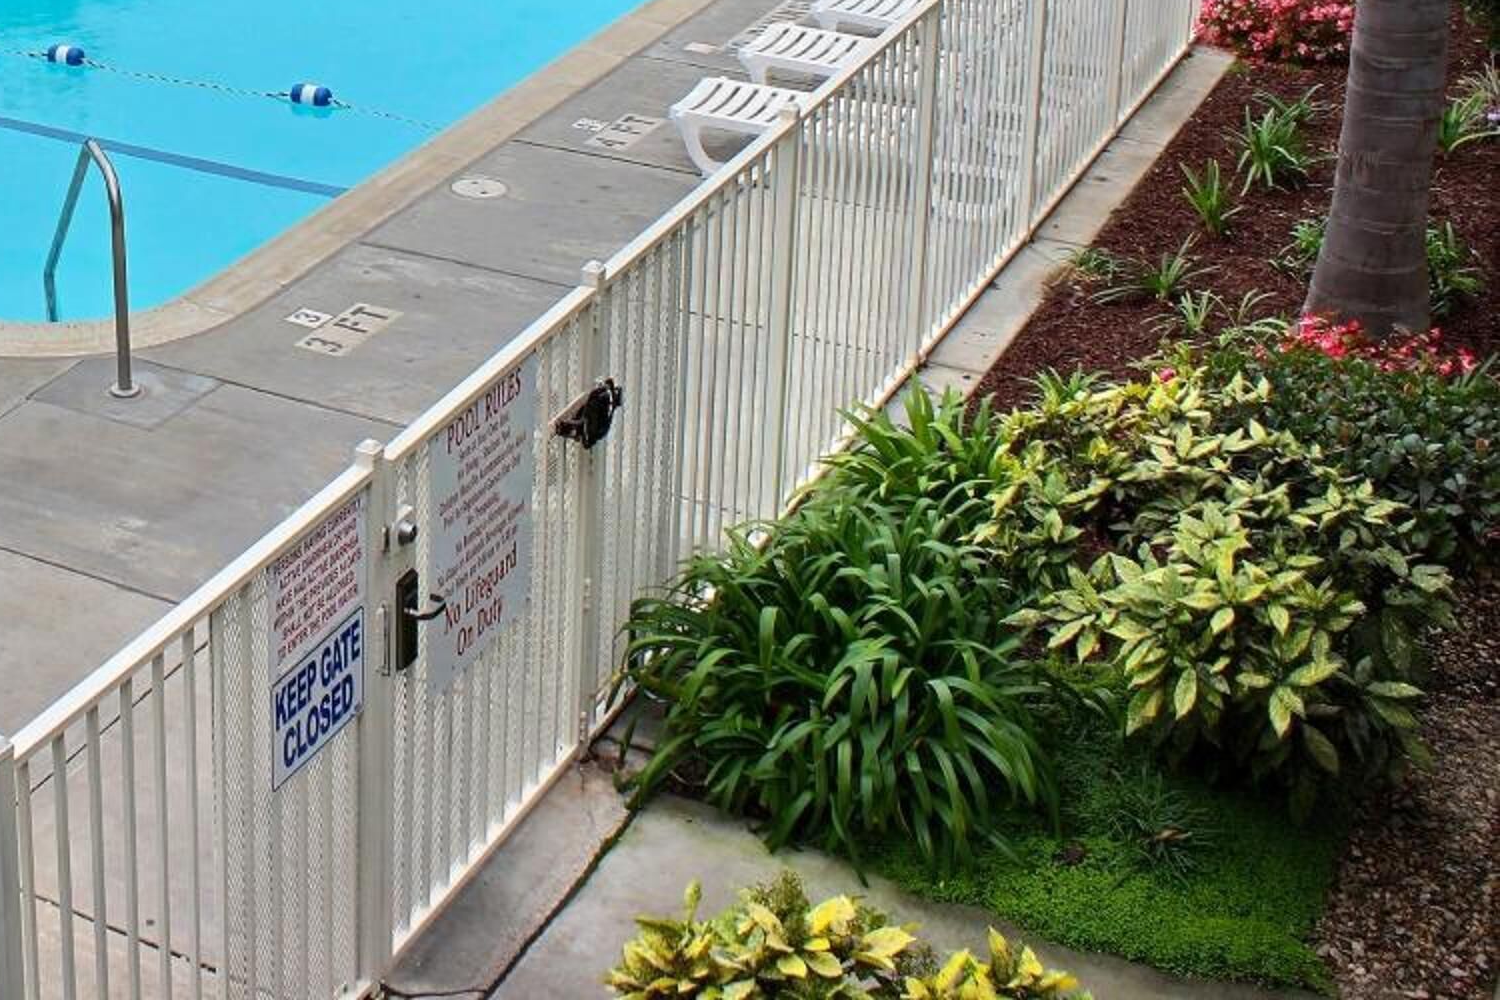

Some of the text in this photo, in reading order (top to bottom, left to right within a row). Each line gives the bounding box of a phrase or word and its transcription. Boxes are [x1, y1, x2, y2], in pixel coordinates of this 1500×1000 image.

[610, 114, 656, 134] FT
[293, 310, 322, 324] 3
[303, 304, 390, 354] 3 FT
[447, 399, 480, 455] POOL
[485, 366, 521, 422] RULES
[443, 602, 461, 636] No
[465, 540, 517, 614] Lifeguard
[457, 597, 503, 656] On Duty
[275, 619, 360, 731] KEEP GATE
[283, 674, 354, 768] CLOSED
